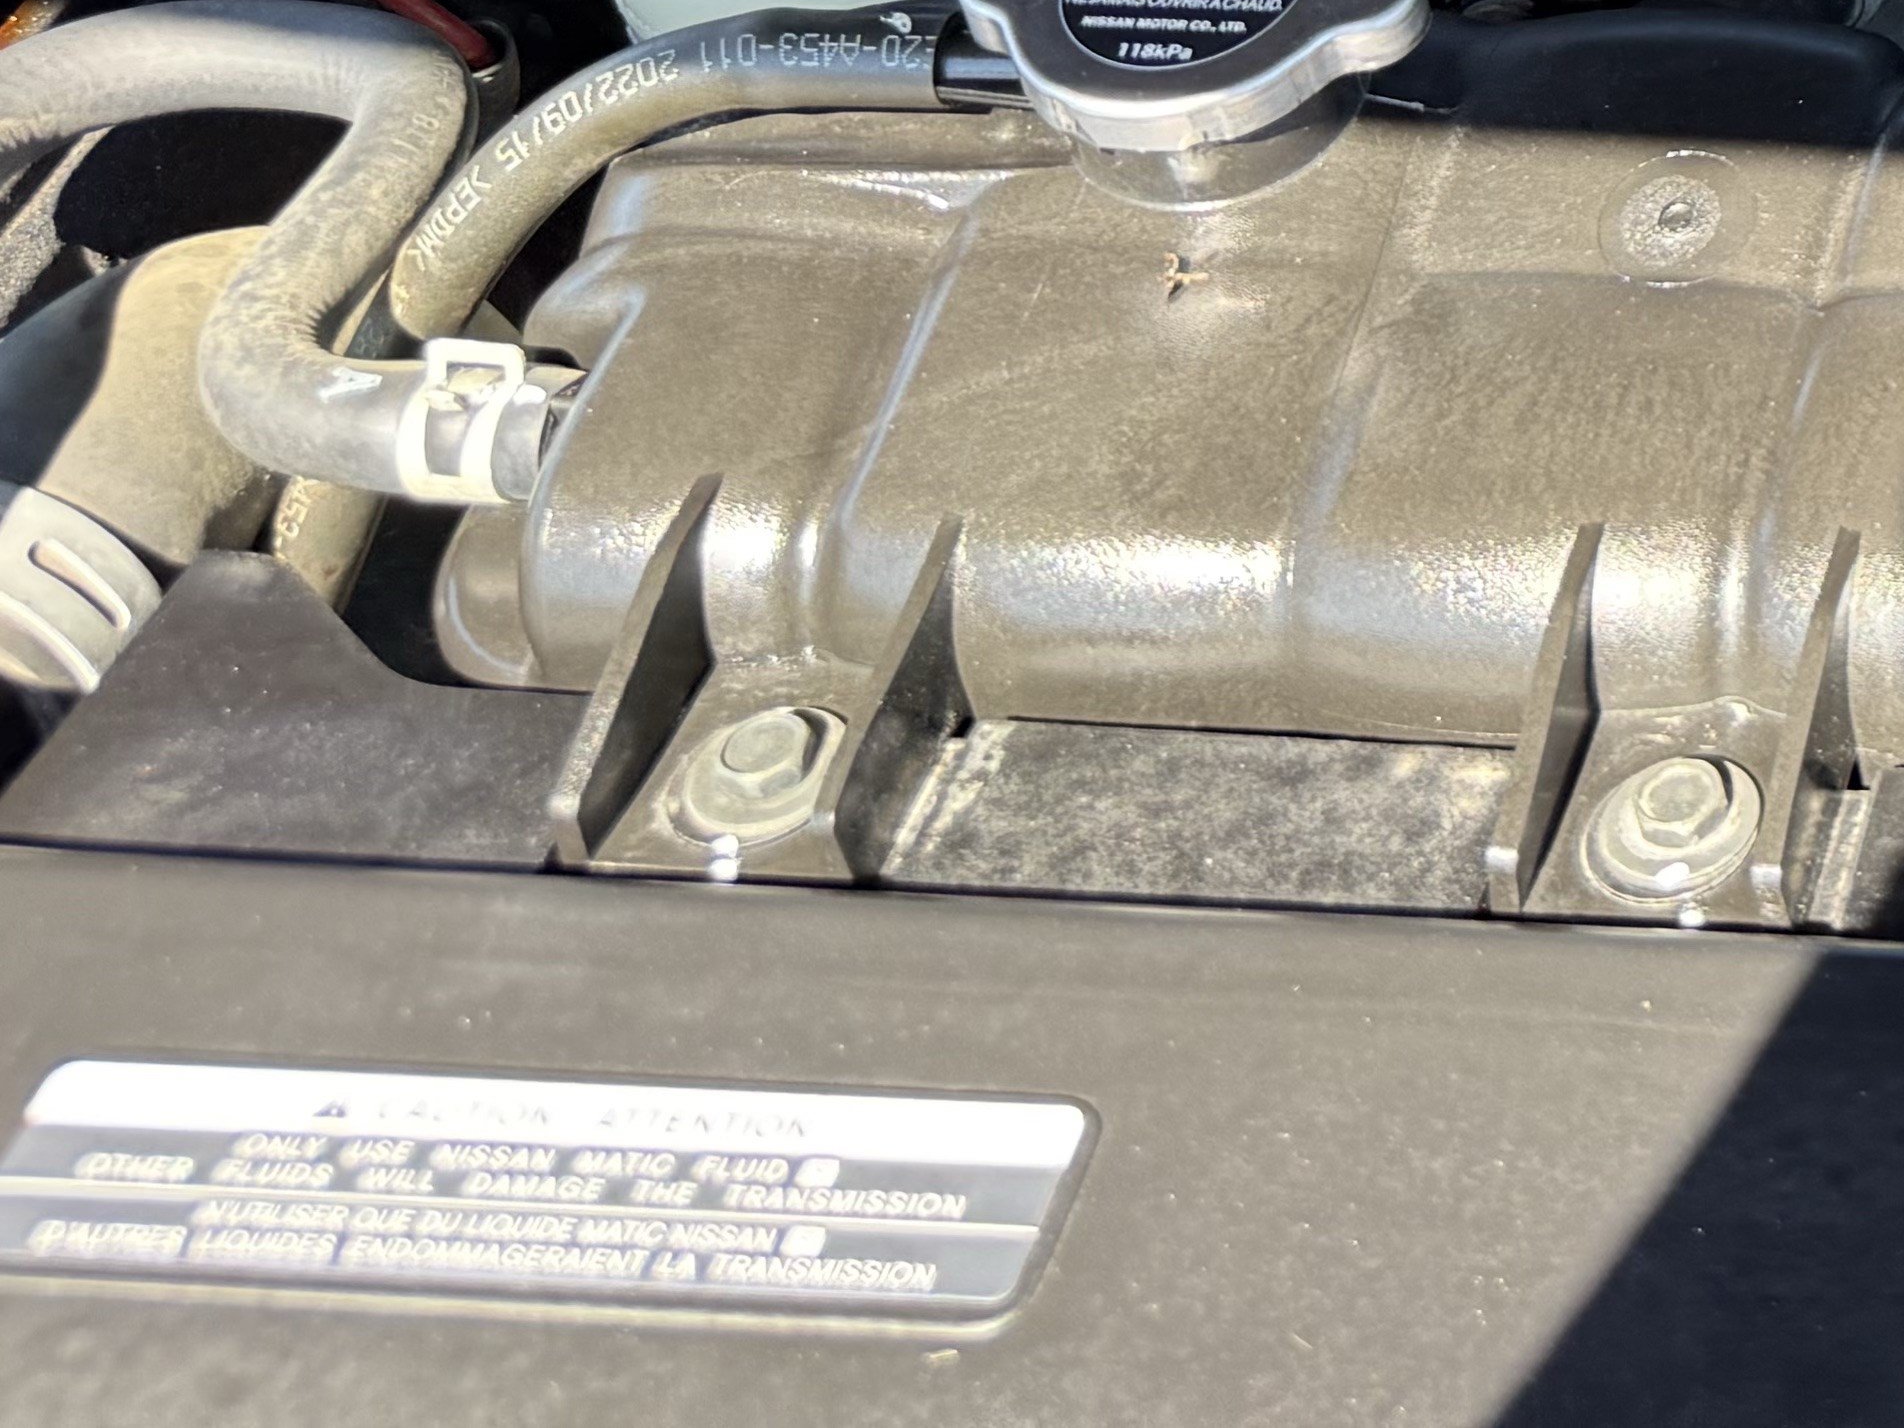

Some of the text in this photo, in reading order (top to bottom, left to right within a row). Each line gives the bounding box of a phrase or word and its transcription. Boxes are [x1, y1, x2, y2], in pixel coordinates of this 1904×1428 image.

[1081, 15, 1134, 29] NISSAN
[1136, 18, 1187, 31] MOTOR
[1118, 42, 1194, 60] 118kPa
[496, 49, 680, 171] 2022/09/15
[242, 1134, 328, 1160] ONLY
[350, 1138, 415, 1165] USE
[434, 1144, 556, 1172] NISSAN
[575, 1151, 677, 1178] MATIC
[692, 1157, 789, 1185] FLUID
[79, 1152, 968, 1220] OTHER FLUIDS WILL DAMAGE THE TRANSMISSION
[351, 1206, 416, 1231] QUE
[419, 1211, 463, 1235] DU
[466, 1213, 576, 1241] LIQUIDE
[577, 1219, 664, 1247] MATIC
[671, 1224, 777, 1253] NISSAN
[191, 1229, 336, 1263] LIQUIDES
[345, 1236, 648, 1276] ENDOMMAGERAIENT
[651, 1252, 696, 1280] LA
[706, 1255, 937, 1293] TRANSMISSION
